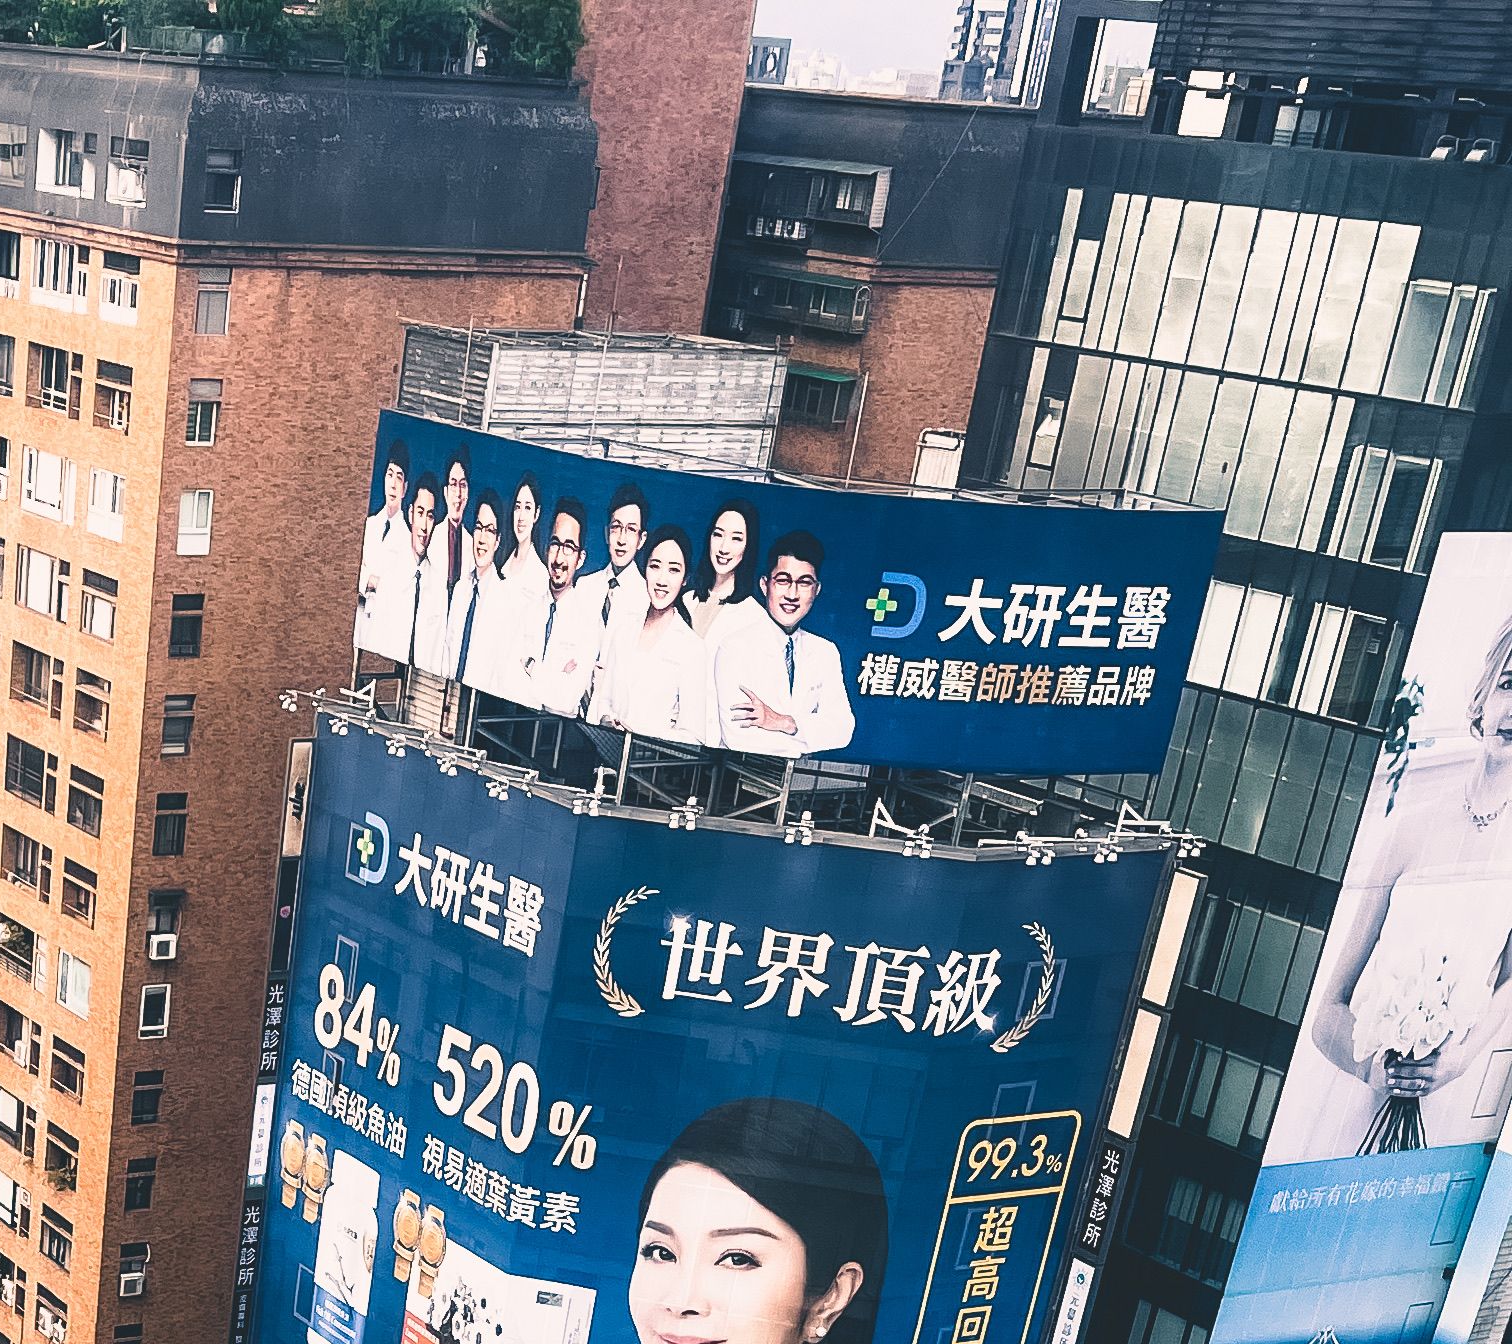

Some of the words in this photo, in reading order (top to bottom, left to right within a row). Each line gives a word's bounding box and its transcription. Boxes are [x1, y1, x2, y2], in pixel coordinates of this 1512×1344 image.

[938, 577, 1170, 652] 大研生醫
[856, 653, 1158, 711] 權威醫師推薦品牌
[394, 832, 546, 959] 大研生醫
[259, 983, 285, 1072] 光澤診所
[313, 963, 401, 1088] 84%
[660, 914, 1005, 1042] 世界頂級
[290, 1058, 408, 1160] 德國頂級魚油
[966, 1134, 1063, 1184] 99.3%
[421, 1132, 581, 1235] 視易適葉黃素
[1082, 1149, 1120, 1249] 光澤診所
[237, 1205, 262, 1286] 光澤診所
